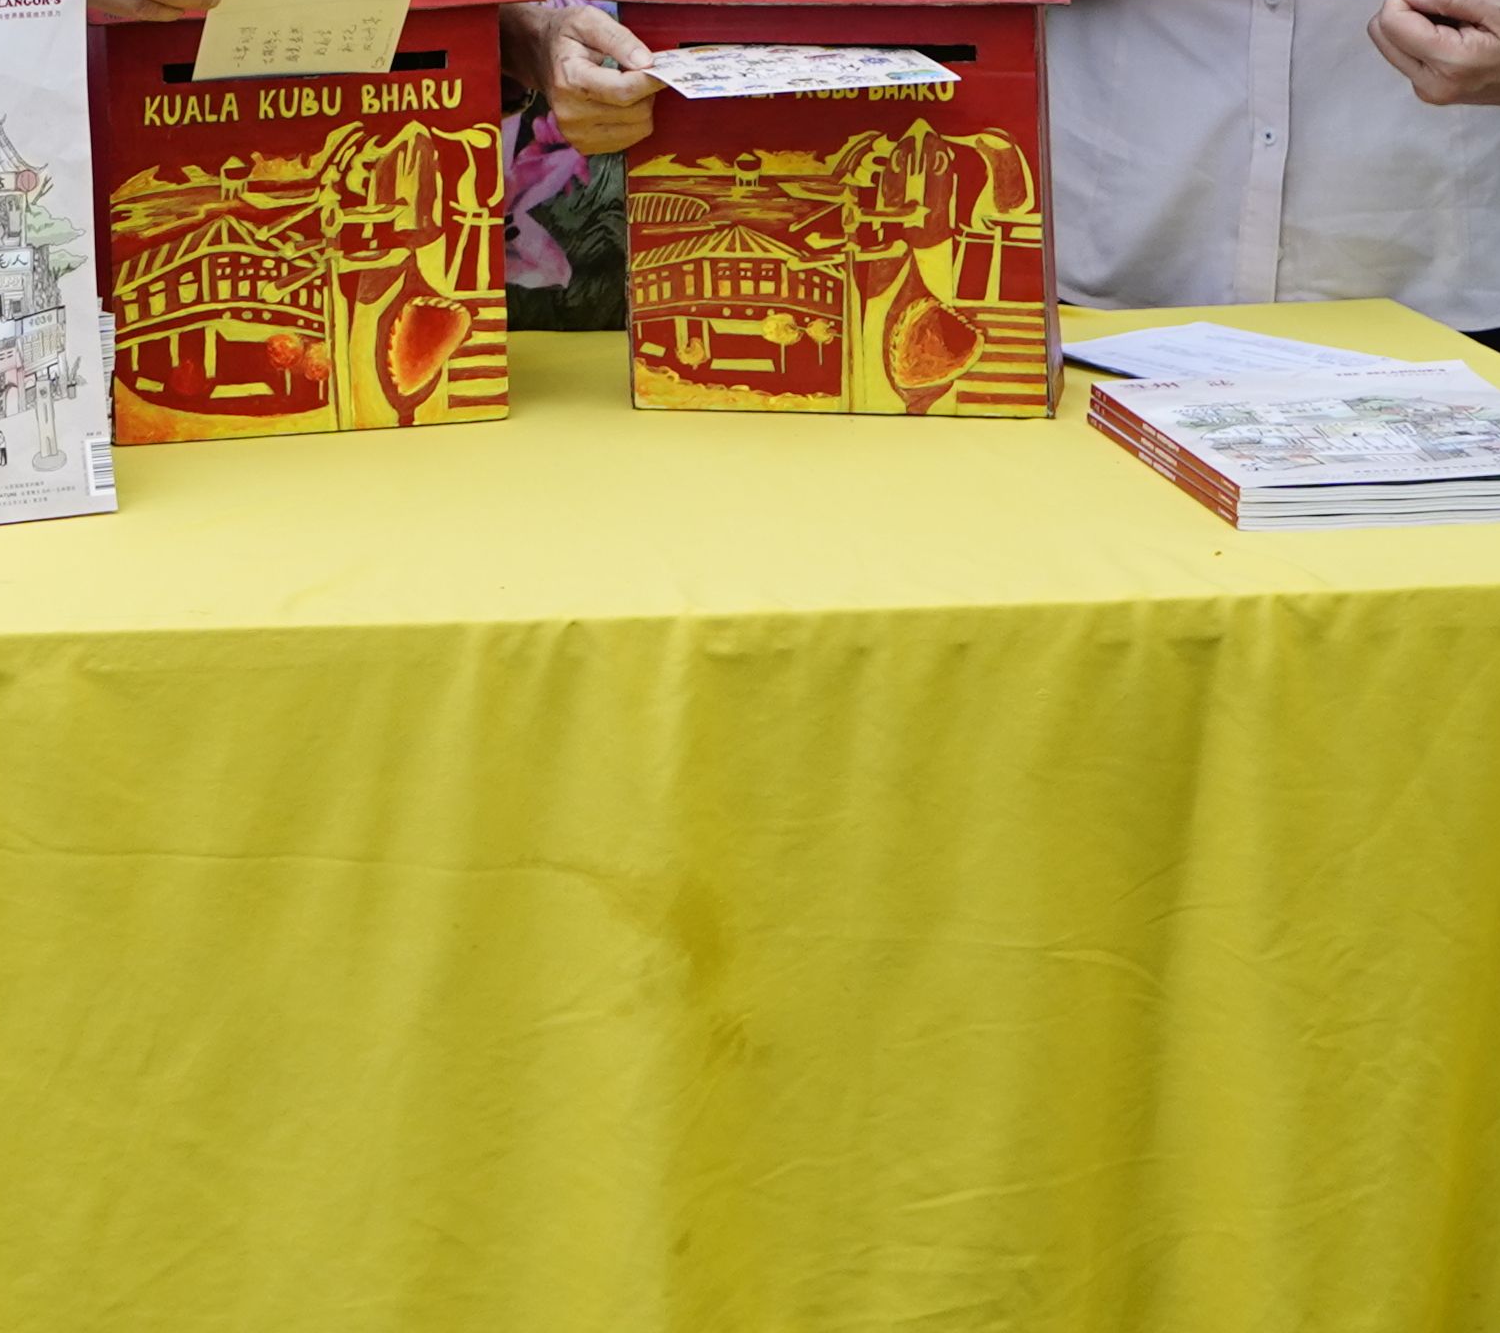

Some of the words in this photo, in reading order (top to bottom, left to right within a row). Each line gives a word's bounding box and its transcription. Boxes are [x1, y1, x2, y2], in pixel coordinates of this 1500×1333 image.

[142, 92, 240, 128] KUALA
[257, 85, 343, 121] KUBU
[359, 78, 464, 116] BHARU
